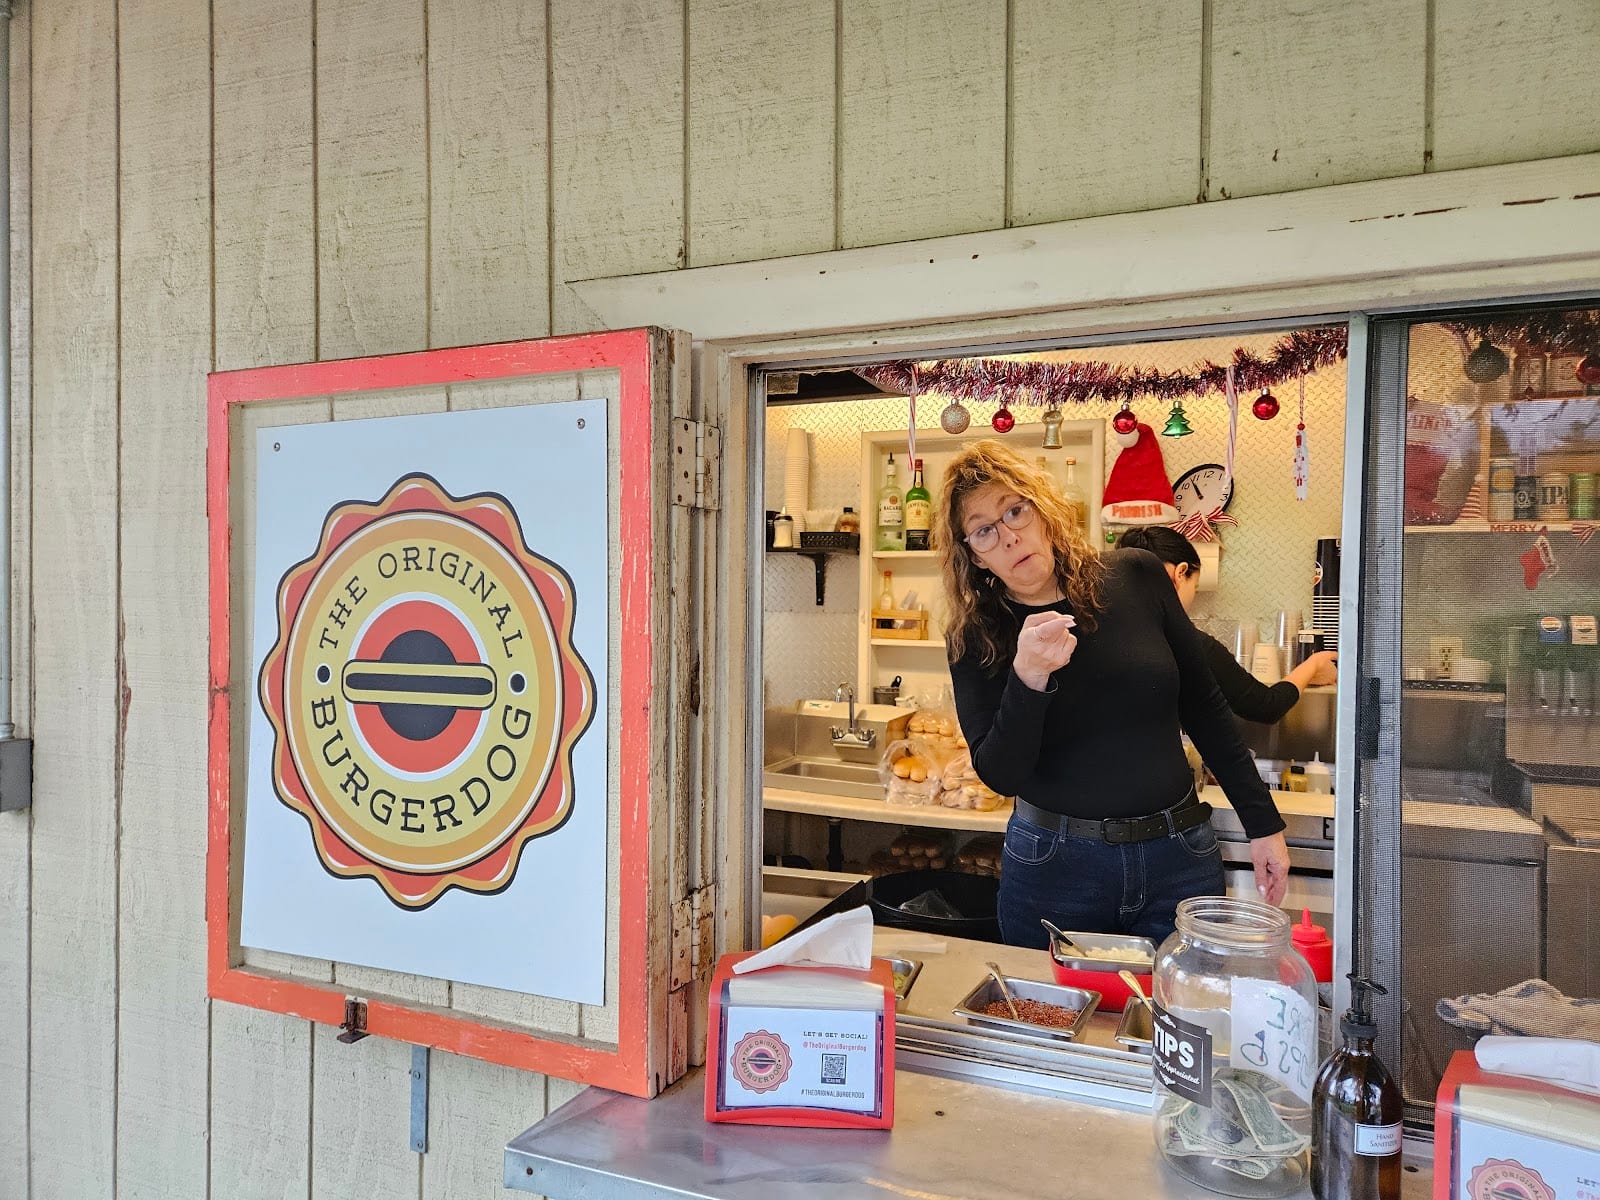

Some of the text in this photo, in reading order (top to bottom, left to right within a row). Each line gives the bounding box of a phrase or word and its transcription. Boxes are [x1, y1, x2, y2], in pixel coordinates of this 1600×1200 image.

[1203, 471, 1215, 479] 12
[1489, 524, 1537, 533] MERRY
[318, 545, 524, 659] THE ORIGINAL
[311, 694, 532, 834] BURGERDOG
[1153, 1020, 1195, 1069] TIPS
